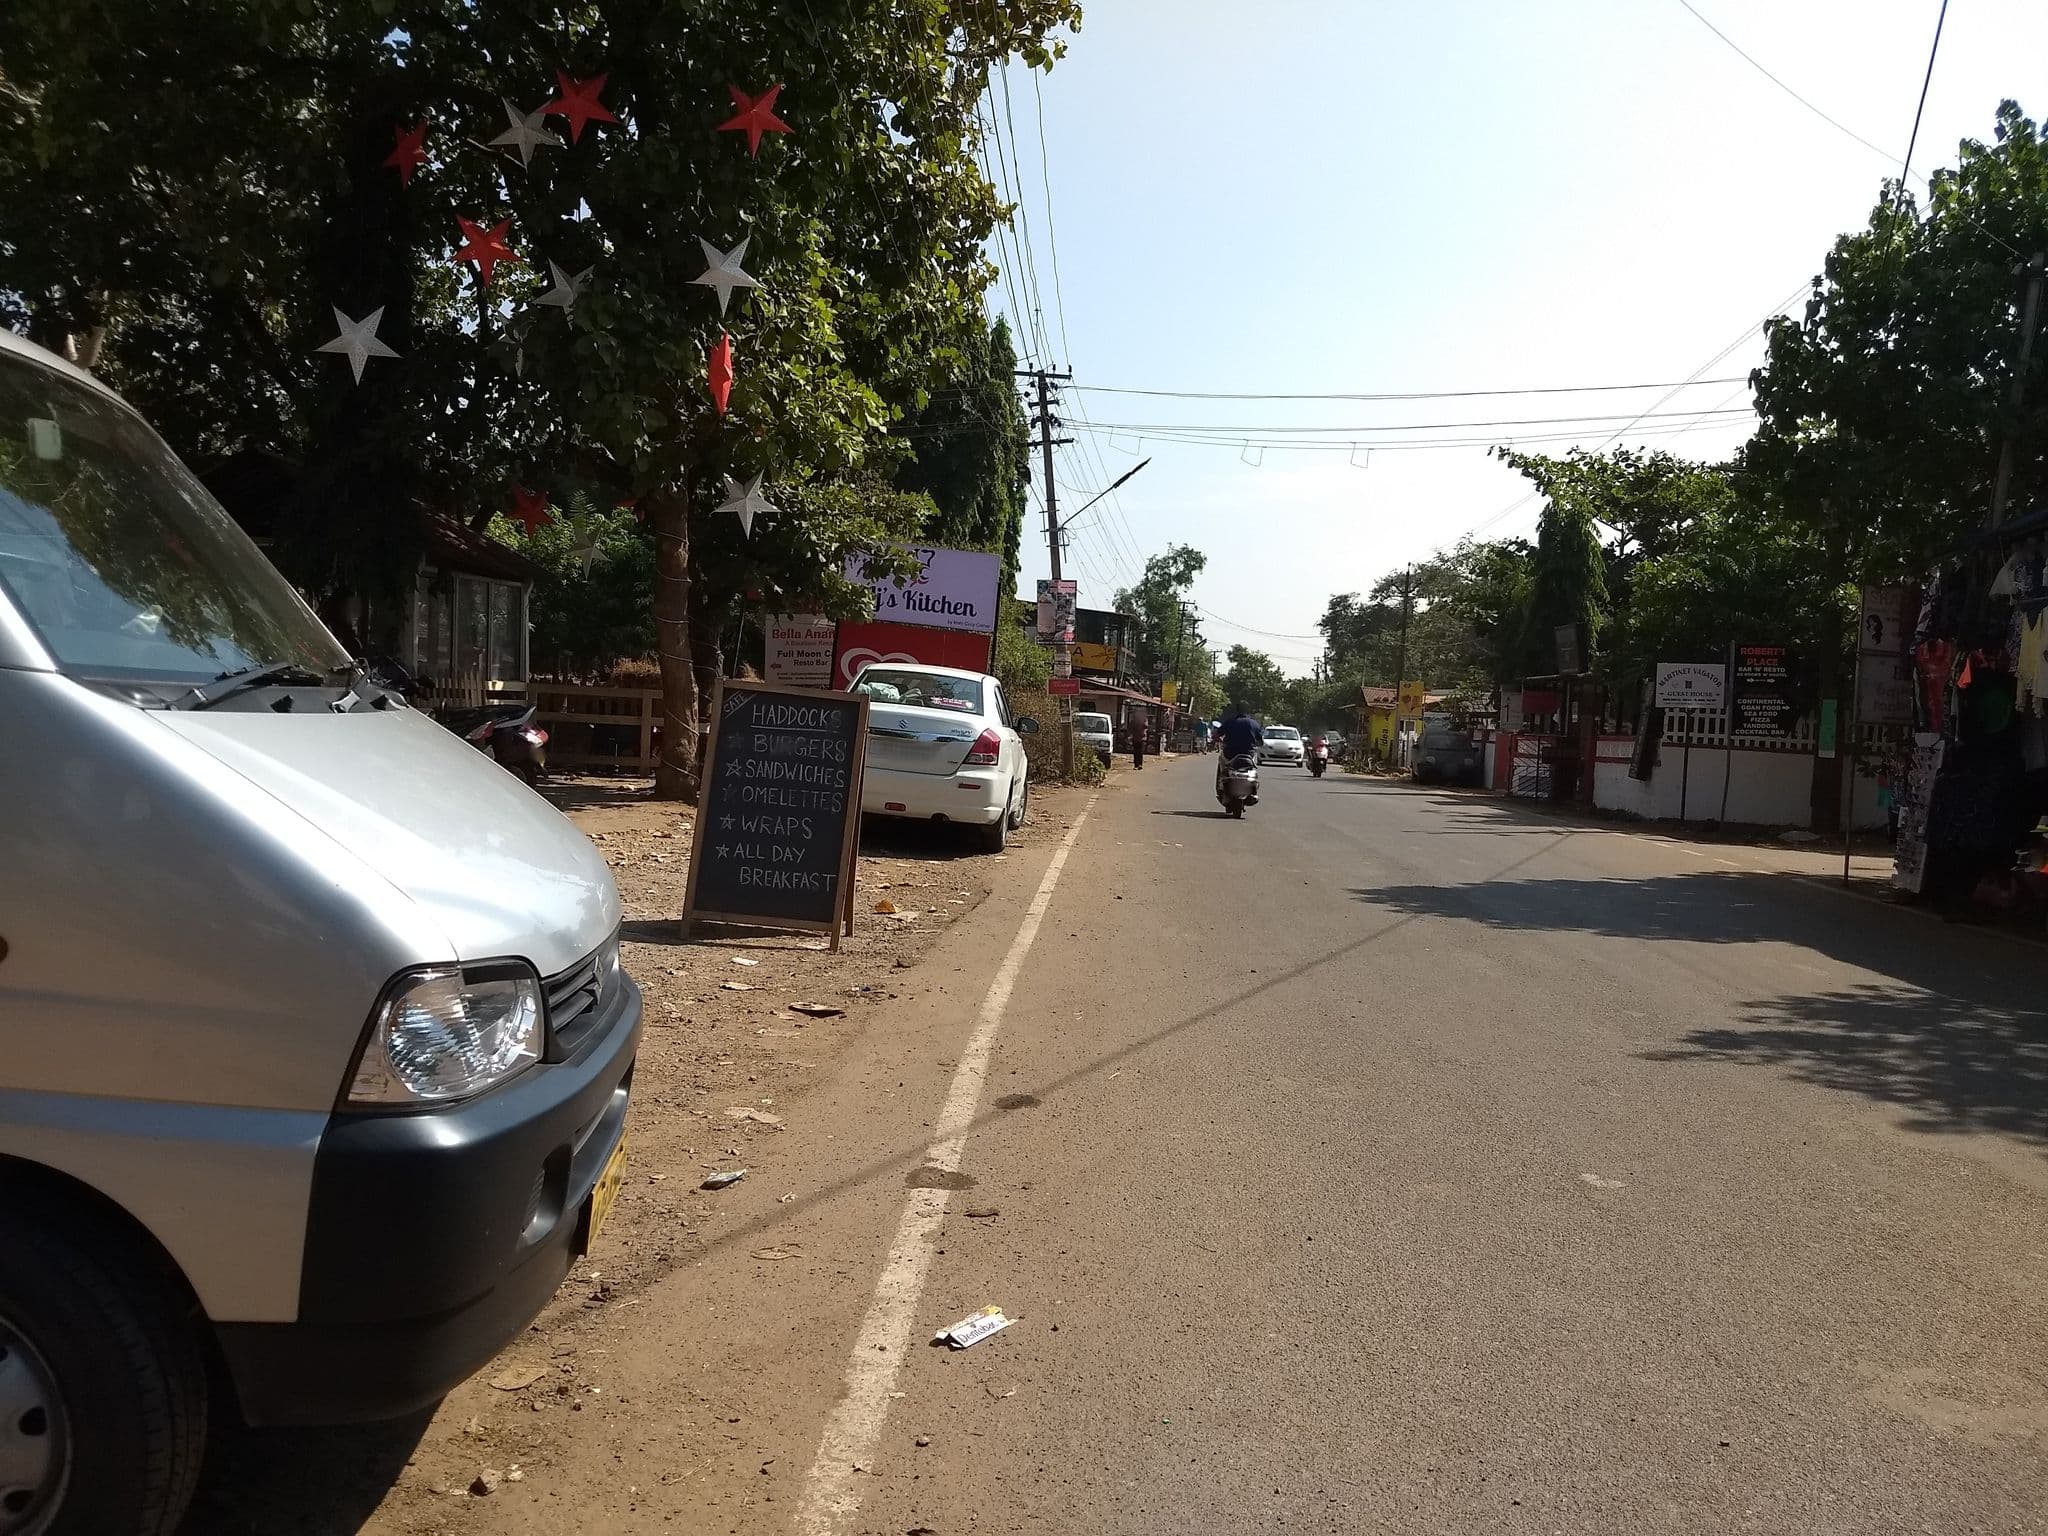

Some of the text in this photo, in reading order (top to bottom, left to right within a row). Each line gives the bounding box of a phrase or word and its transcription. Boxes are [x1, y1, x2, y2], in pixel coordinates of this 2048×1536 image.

[872, 585, 978, 617] j's Kitchen
[772, 628, 801, 639] Bella
[777, 649, 794, 658] Full
[797, 649, 822, 658] Moon
[1746, 657, 1778, 666] PLACE
[752, 704, 842, 729] HADDOCKS
[745, 758, 846, 788] SANDWICHES
[742, 785, 843, 813] OMELETTES
[742, 815, 813, 840] WRAPS
[734, 843, 806, 863] ALL DAY
[739, 866, 837, 892] BREAKFAST
